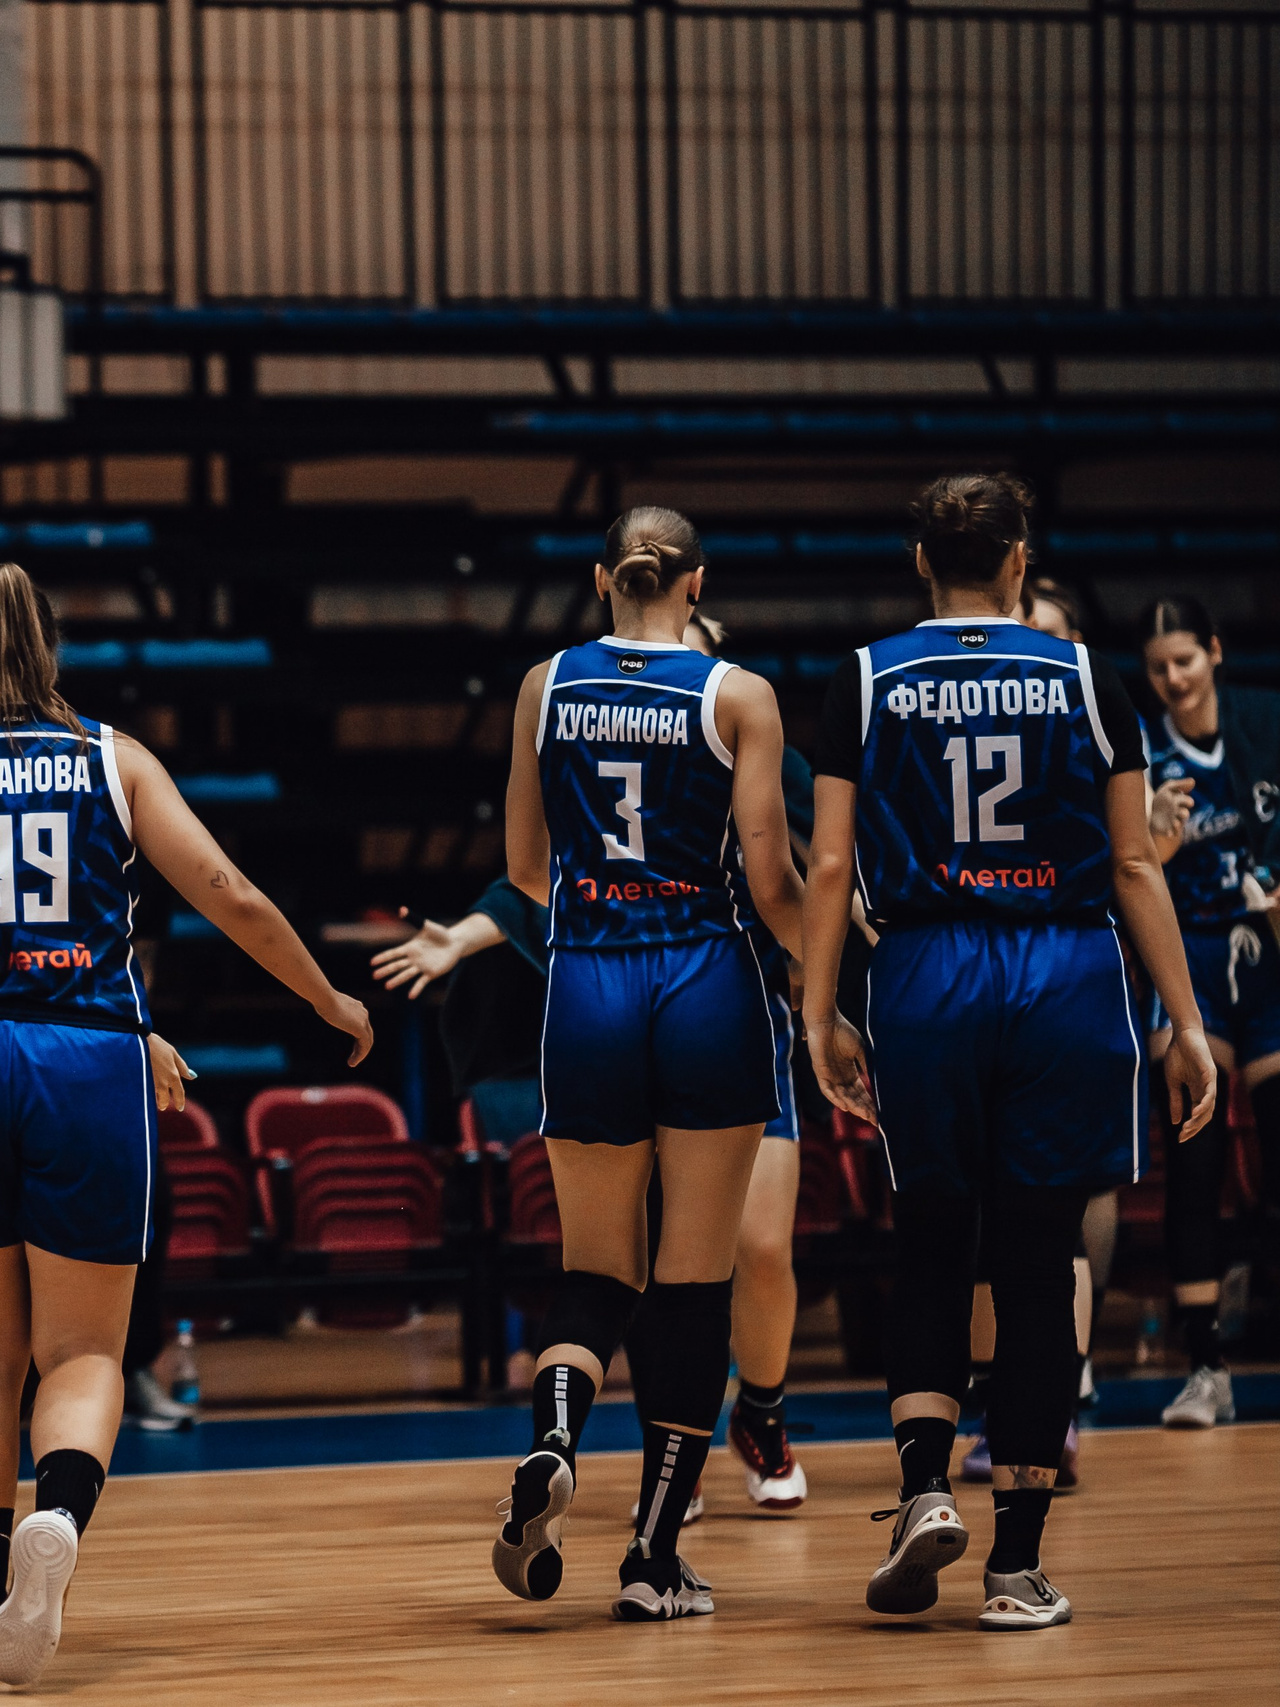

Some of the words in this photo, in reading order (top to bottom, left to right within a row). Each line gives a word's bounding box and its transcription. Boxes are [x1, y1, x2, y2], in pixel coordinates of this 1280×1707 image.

[961, 634, 985, 643] РФБ
[621, 659, 644, 669] РФБ
[886, 678, 1070, 724] ФЕДОТОВА
[556, 703, 689, 745] ХУСАИНОВА
[943, 735, 1024, 842] 12
[598, 761, 645, 862] 3
[959, 861, 1056, 888] летай
